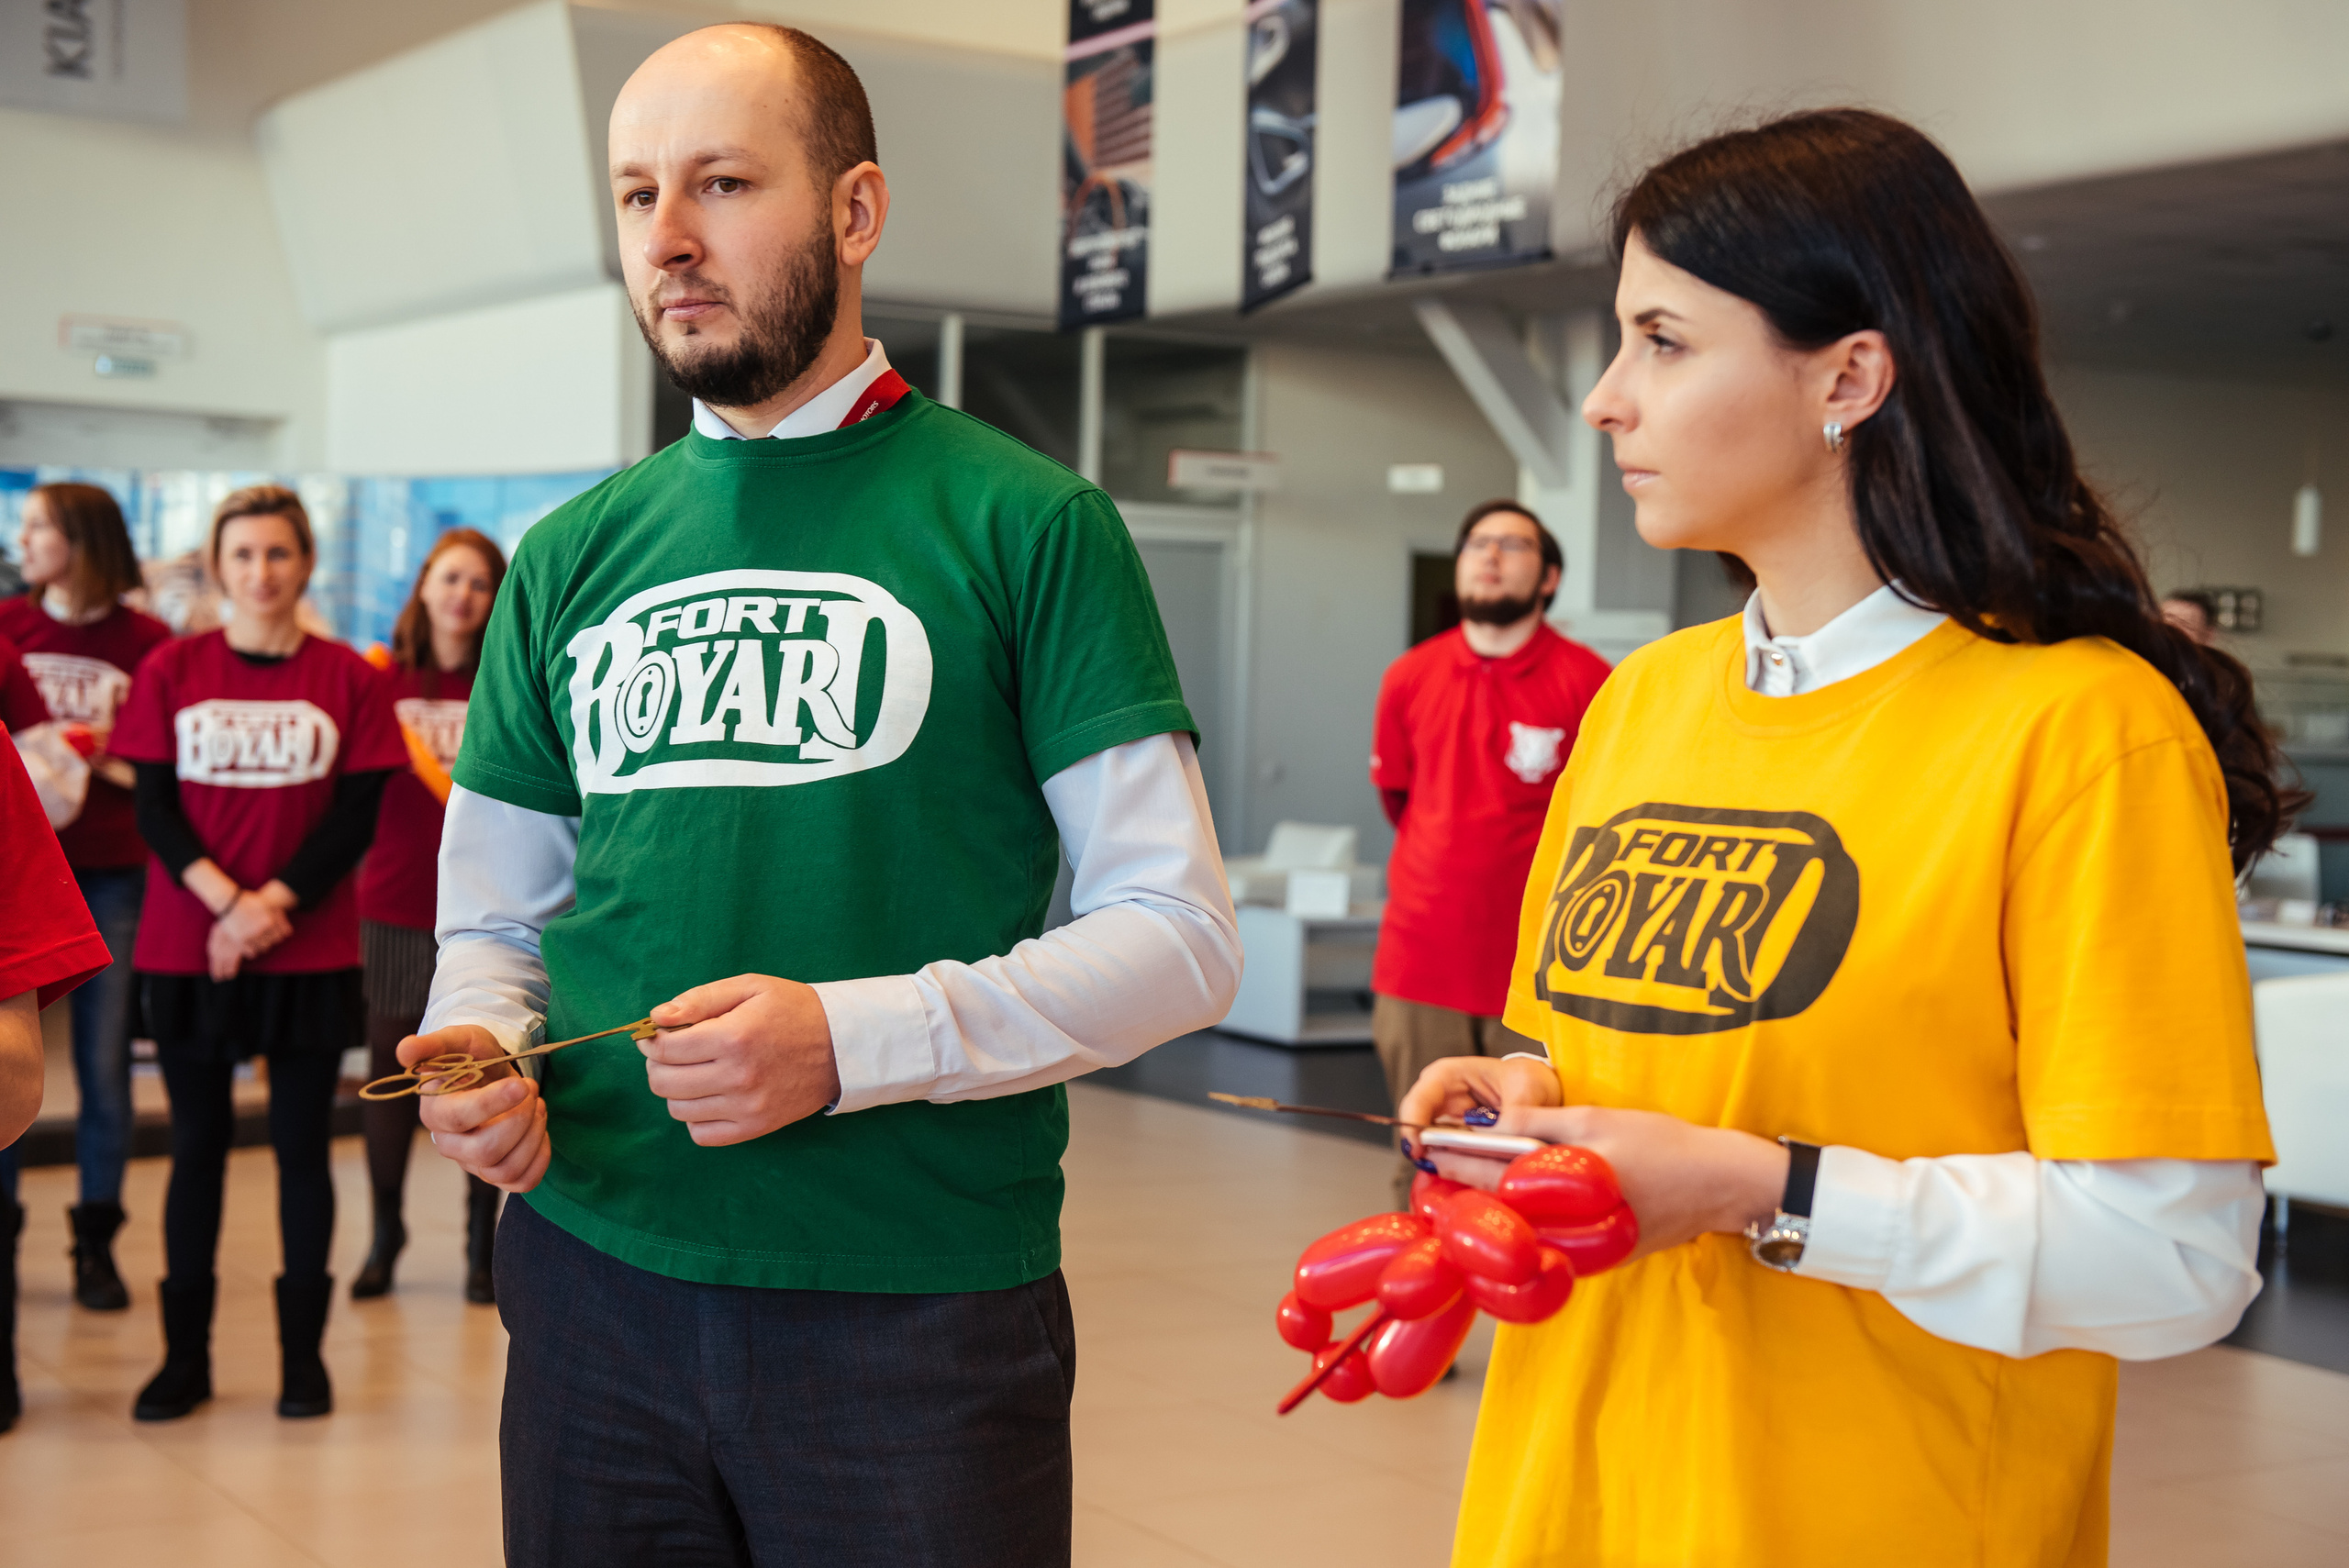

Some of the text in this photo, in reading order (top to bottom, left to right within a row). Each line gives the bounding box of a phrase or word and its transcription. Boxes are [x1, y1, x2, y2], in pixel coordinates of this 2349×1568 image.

[566, 569, 933, 799] BOYARD
[644, 595, 822, 648] FORT
[1535, 802, 1860, 1035] BOYARD
[1618, 828, 1776, 873] FORT
